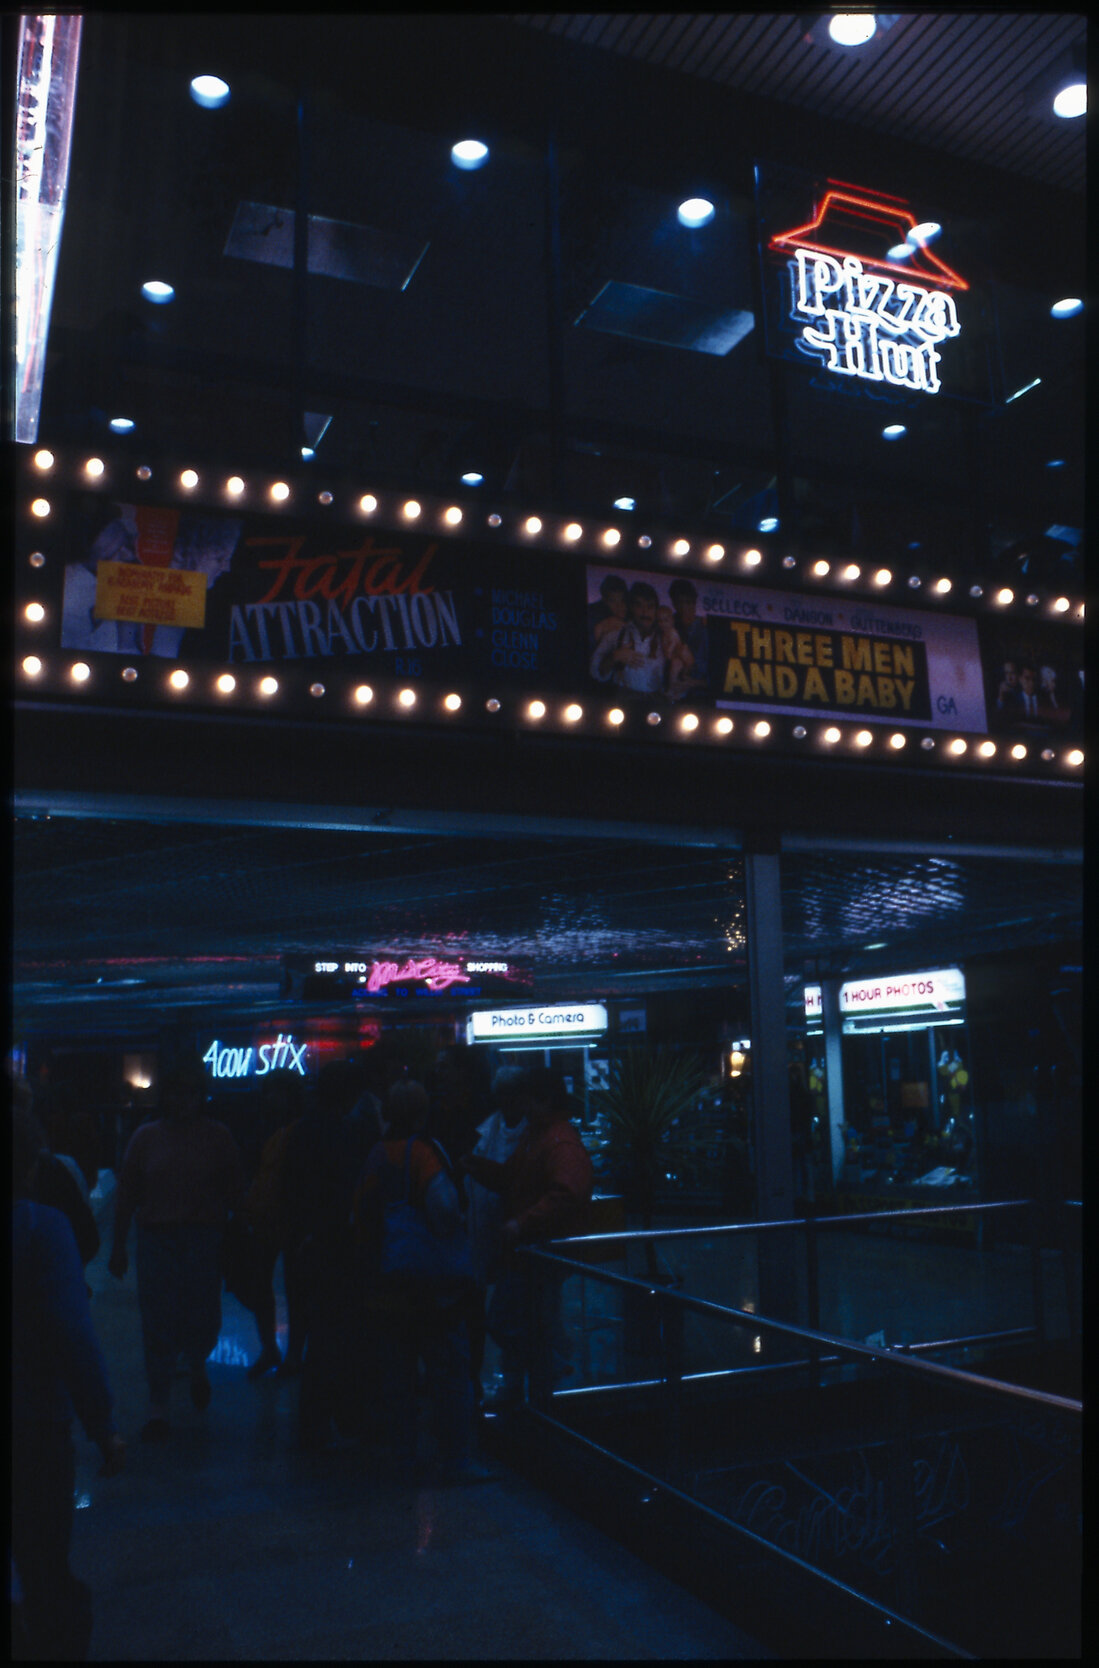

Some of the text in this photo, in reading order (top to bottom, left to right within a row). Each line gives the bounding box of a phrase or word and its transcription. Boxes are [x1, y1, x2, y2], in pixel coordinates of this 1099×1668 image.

[795, 248, 961, 343] Pizza
[803, 309, 942, 395] Hut
[245, 536, 438, 612] Fatal
[491, 588, 546, 610] MICHAEL
[702, 595, 762, 619] SELLECK
[783, 606, 833, 626] DANSON
[227, 590, 463, 664] ATTRACTION
[491, 606, 558, 631] DOUGLAS
[491, 629, 539, 652] GLENN
[730, 621, 916, 678] THREE MEN
[491, 648, 539, 671] CLOSE
[724, 657, 916, 711] AND A BABY
[937, 694, 959, 716] GA
[315, 962, 339, 973] STEP
[344, 962, 367, 973] INTO
[466, 962, 508, 973] SHOPPING
[851, 986, 882, 1003] HOUR
[886, 980, 935, 997] PHOTOS
[491, 1012, 585, 1027] Photo & Camera
